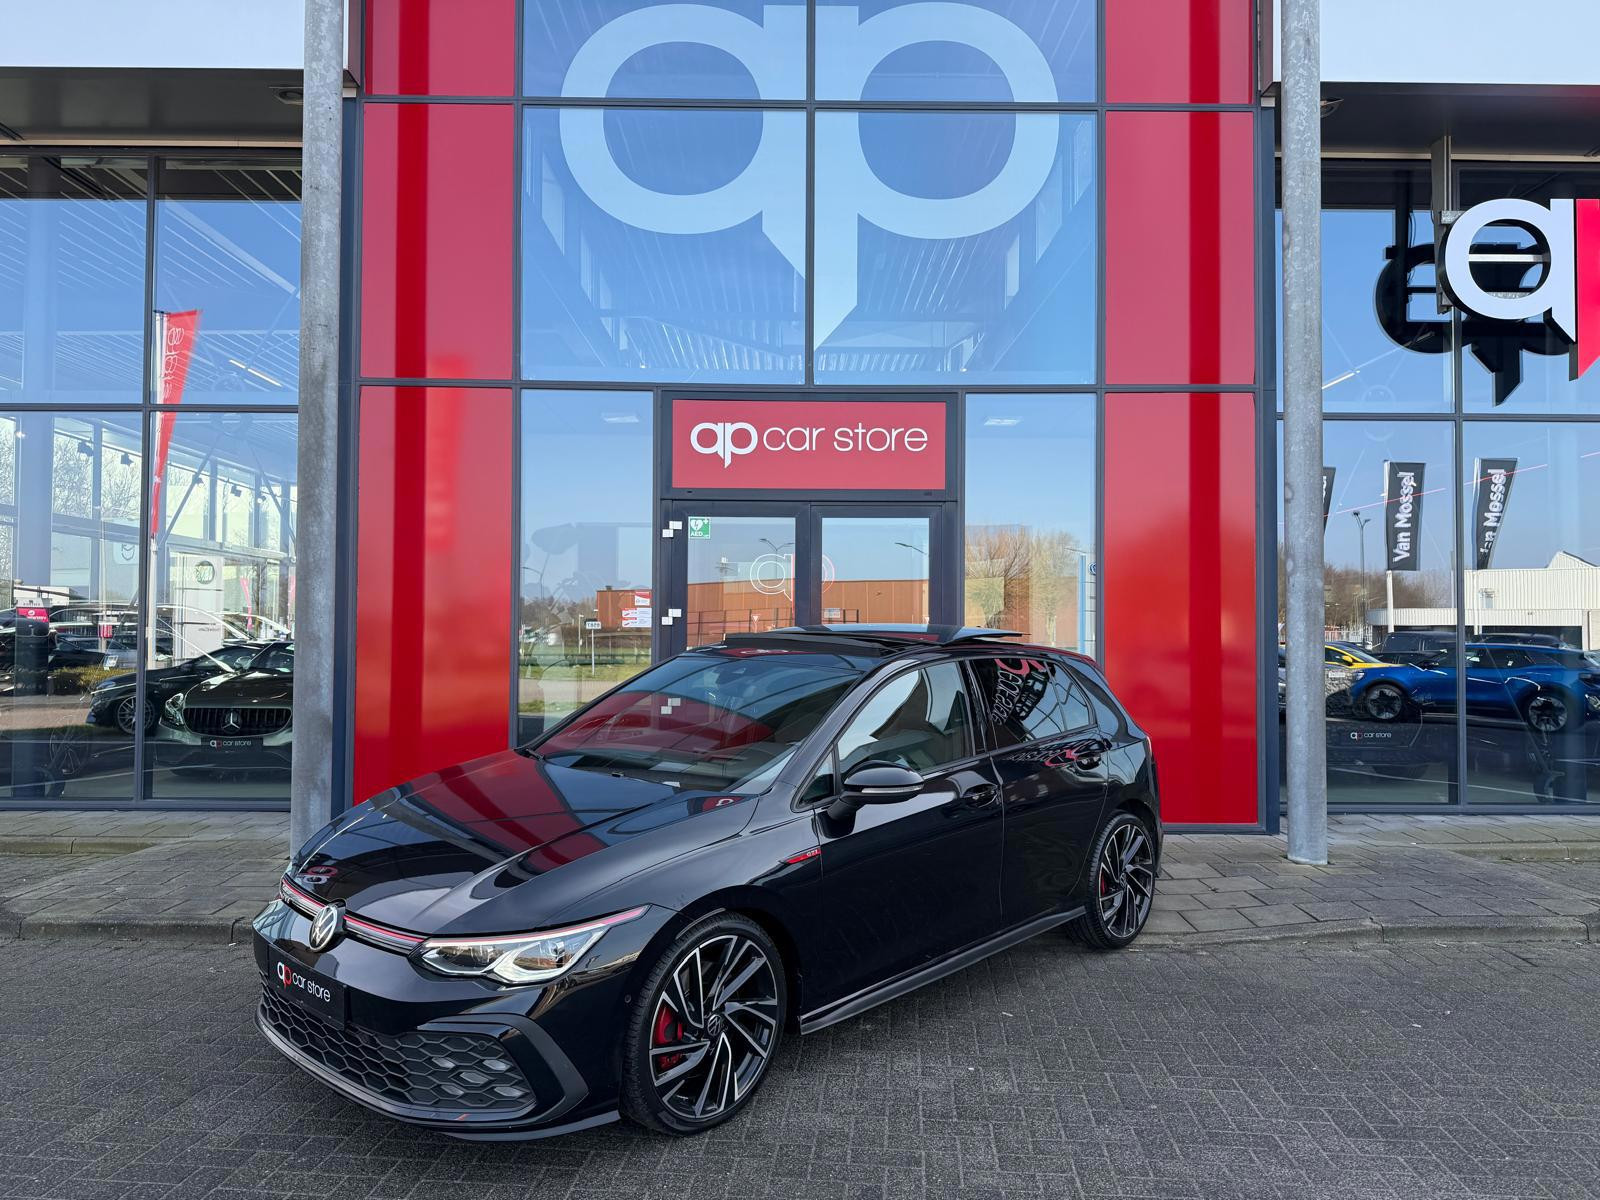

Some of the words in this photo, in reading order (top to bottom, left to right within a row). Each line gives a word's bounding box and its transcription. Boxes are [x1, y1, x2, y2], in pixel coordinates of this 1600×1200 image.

[763, 427, 826, 451] car
[833, 422, 929, 452] store
[1394, 472, 1415, 528] Mossel
[1483, 468, 1507, 528] Mossel
[1392, 532, 1411, 562] Van
[292, 972, 306, 989] car
[307, 980, 331, 1002] store
